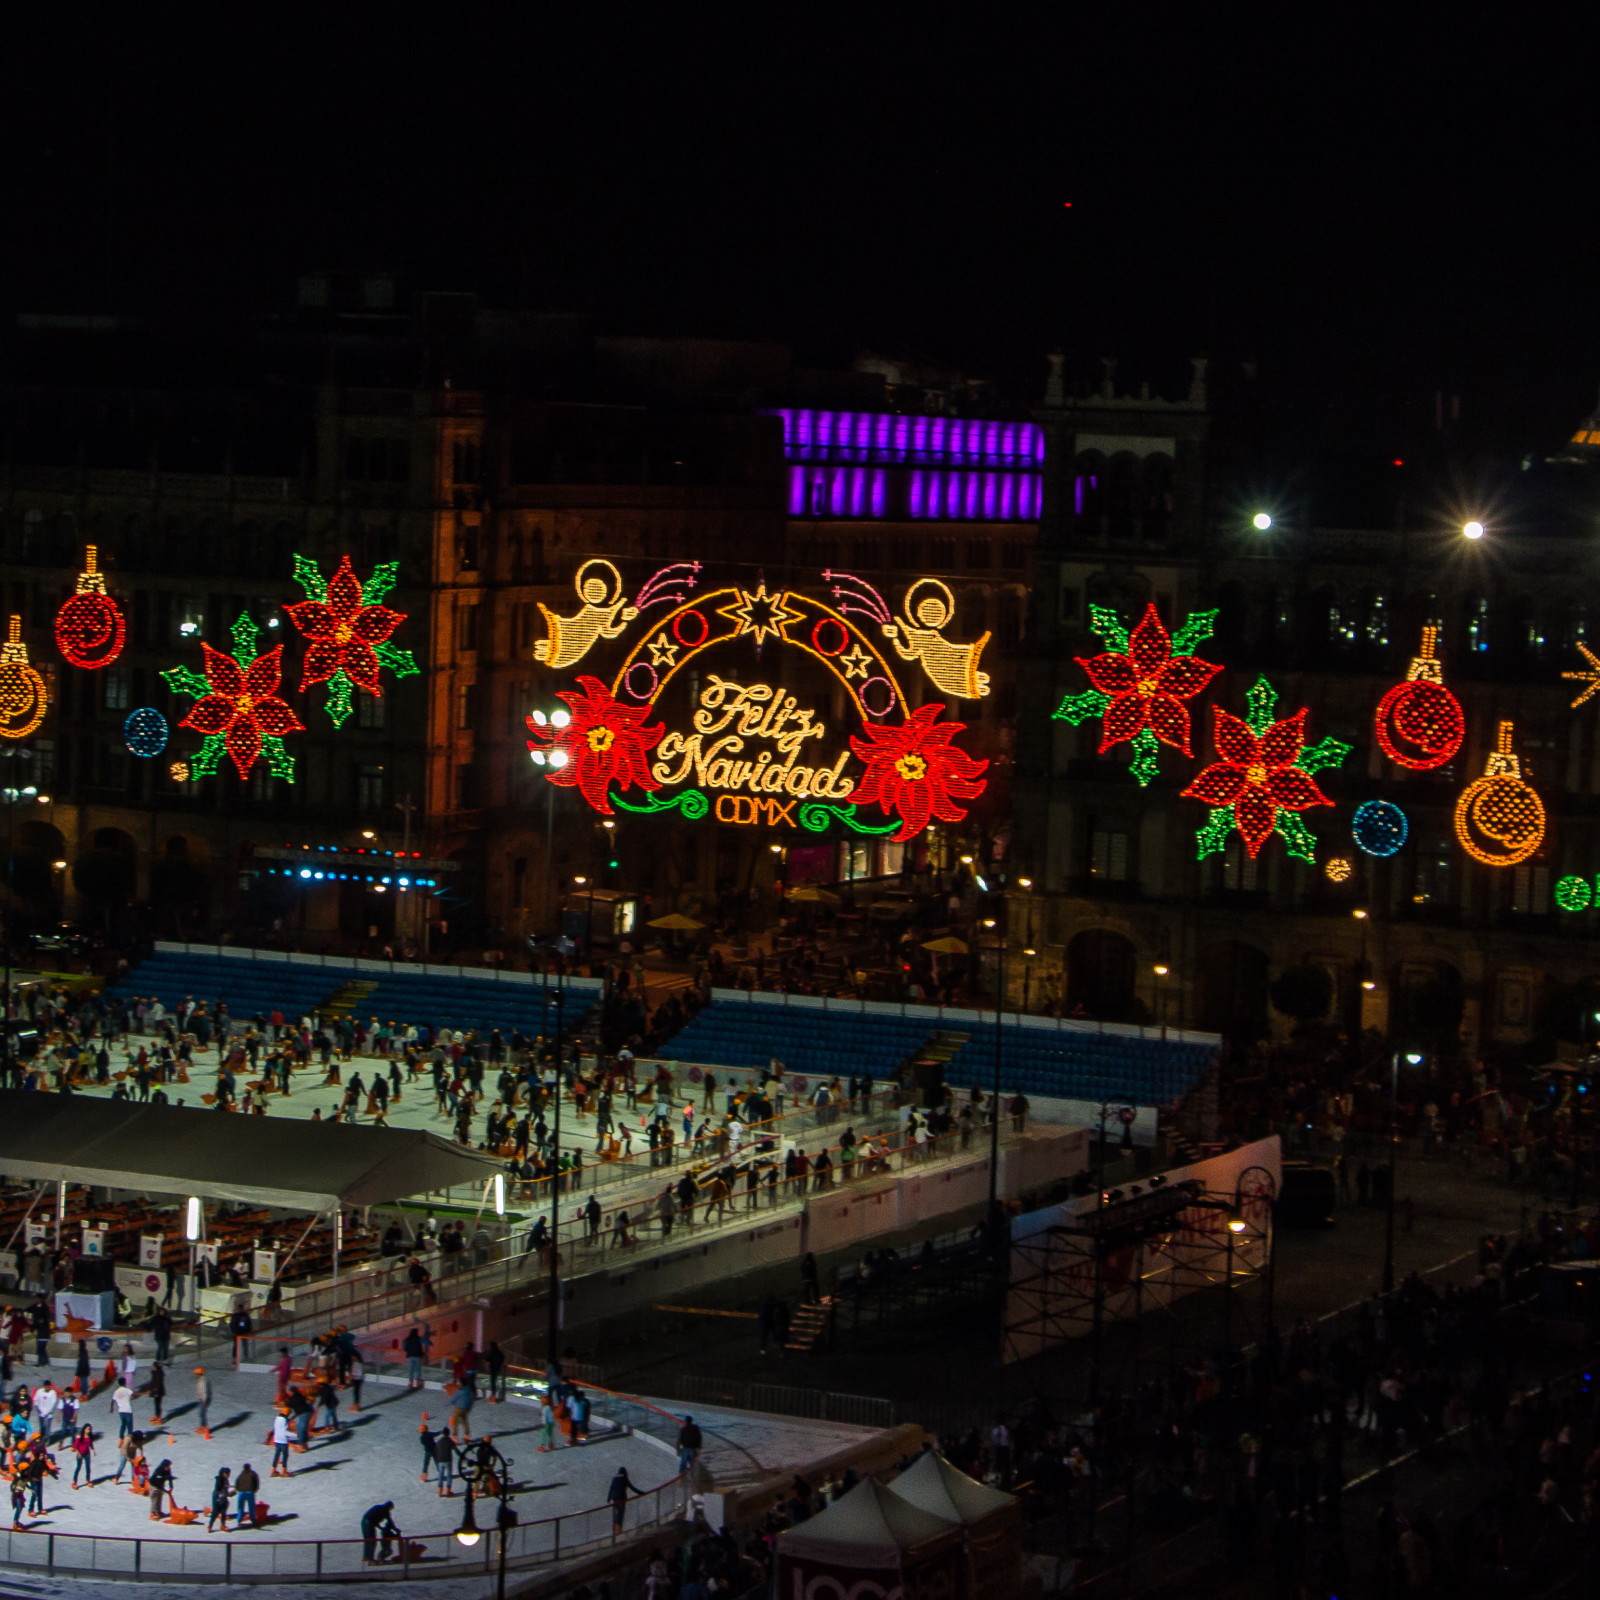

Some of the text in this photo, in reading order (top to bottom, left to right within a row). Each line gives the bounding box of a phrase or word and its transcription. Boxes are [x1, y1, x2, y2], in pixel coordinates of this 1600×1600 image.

[693, 674, 825, 752] Feliz
[651, 732, 854, 798] Navidad
[715, 795, 797, 827] CDMX
